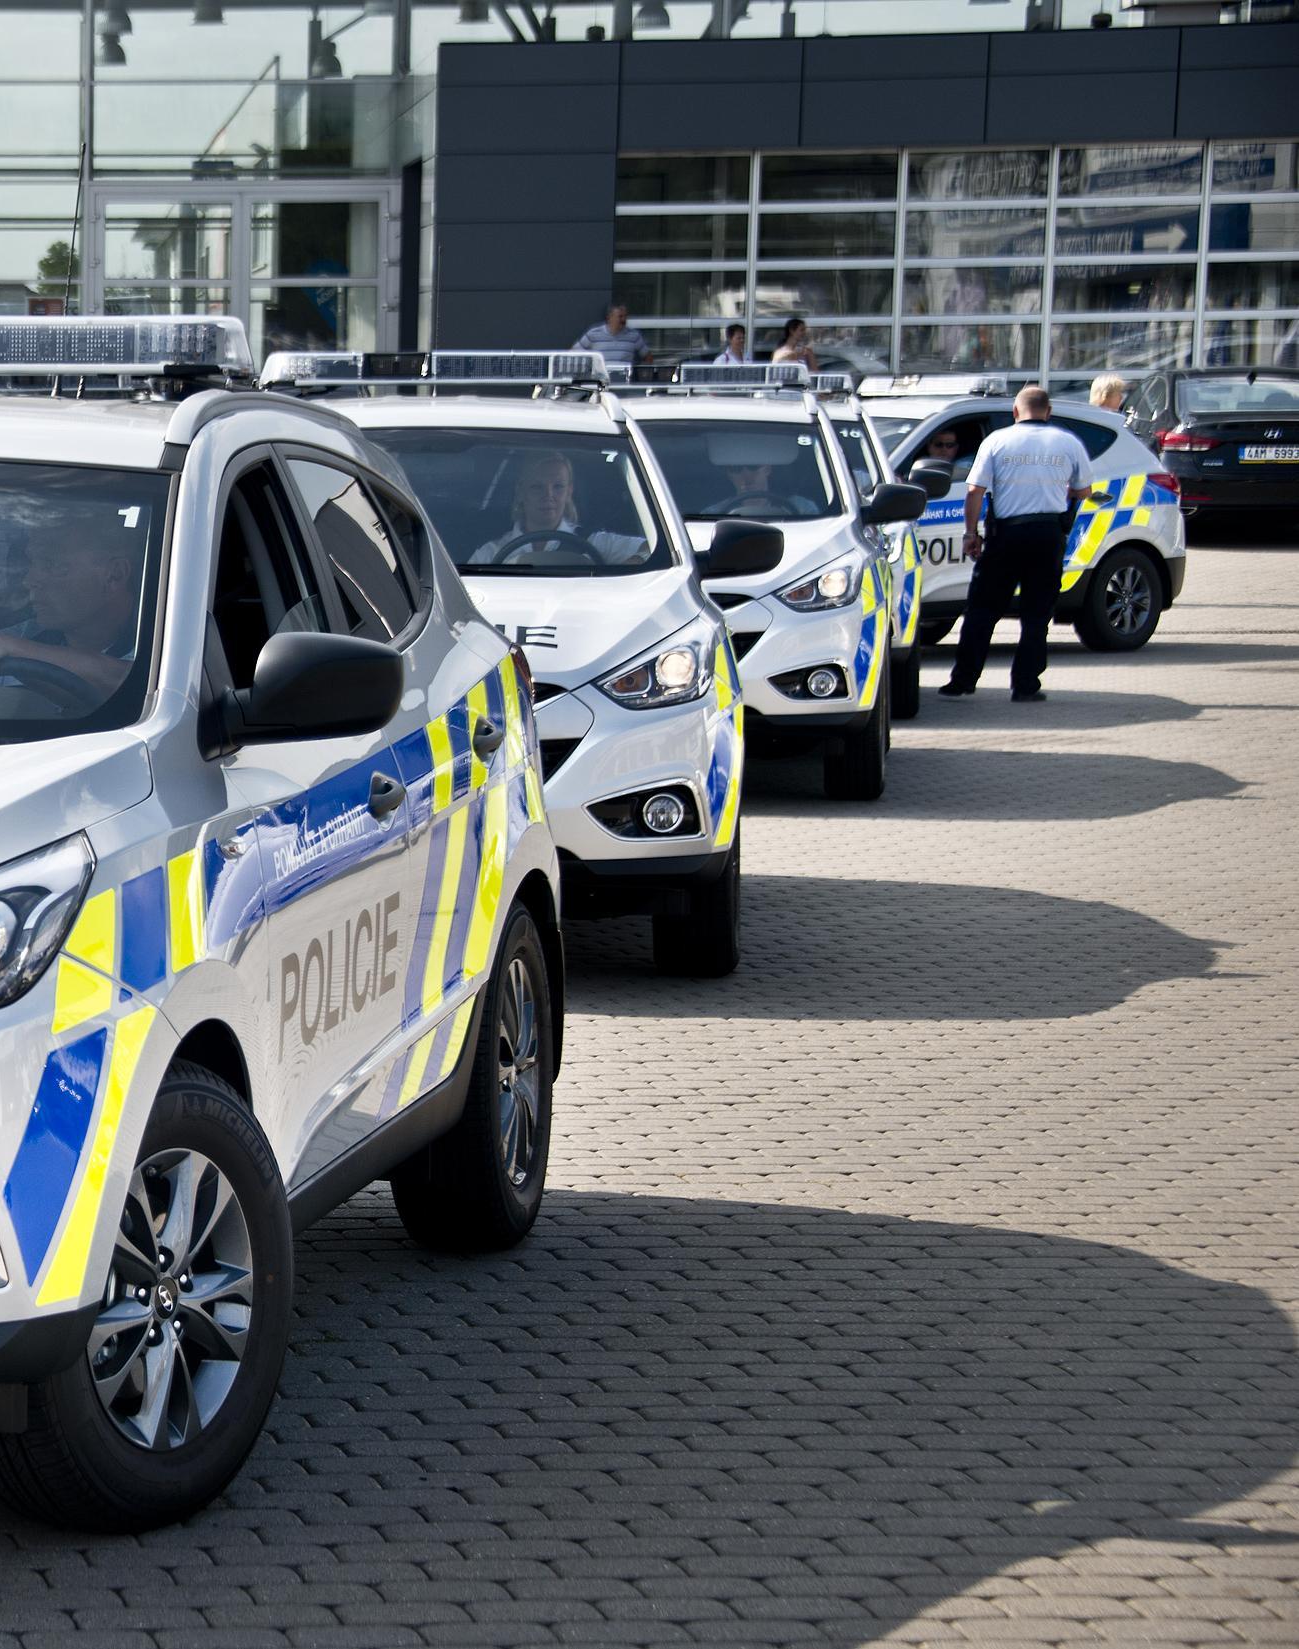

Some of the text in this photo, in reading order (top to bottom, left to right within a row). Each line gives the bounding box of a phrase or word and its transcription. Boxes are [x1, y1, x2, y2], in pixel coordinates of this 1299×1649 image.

[601, 450, 618, 463] 7
[118, 506, 140, 528] 1
[278, 891, 400, 1065] POLICIE
